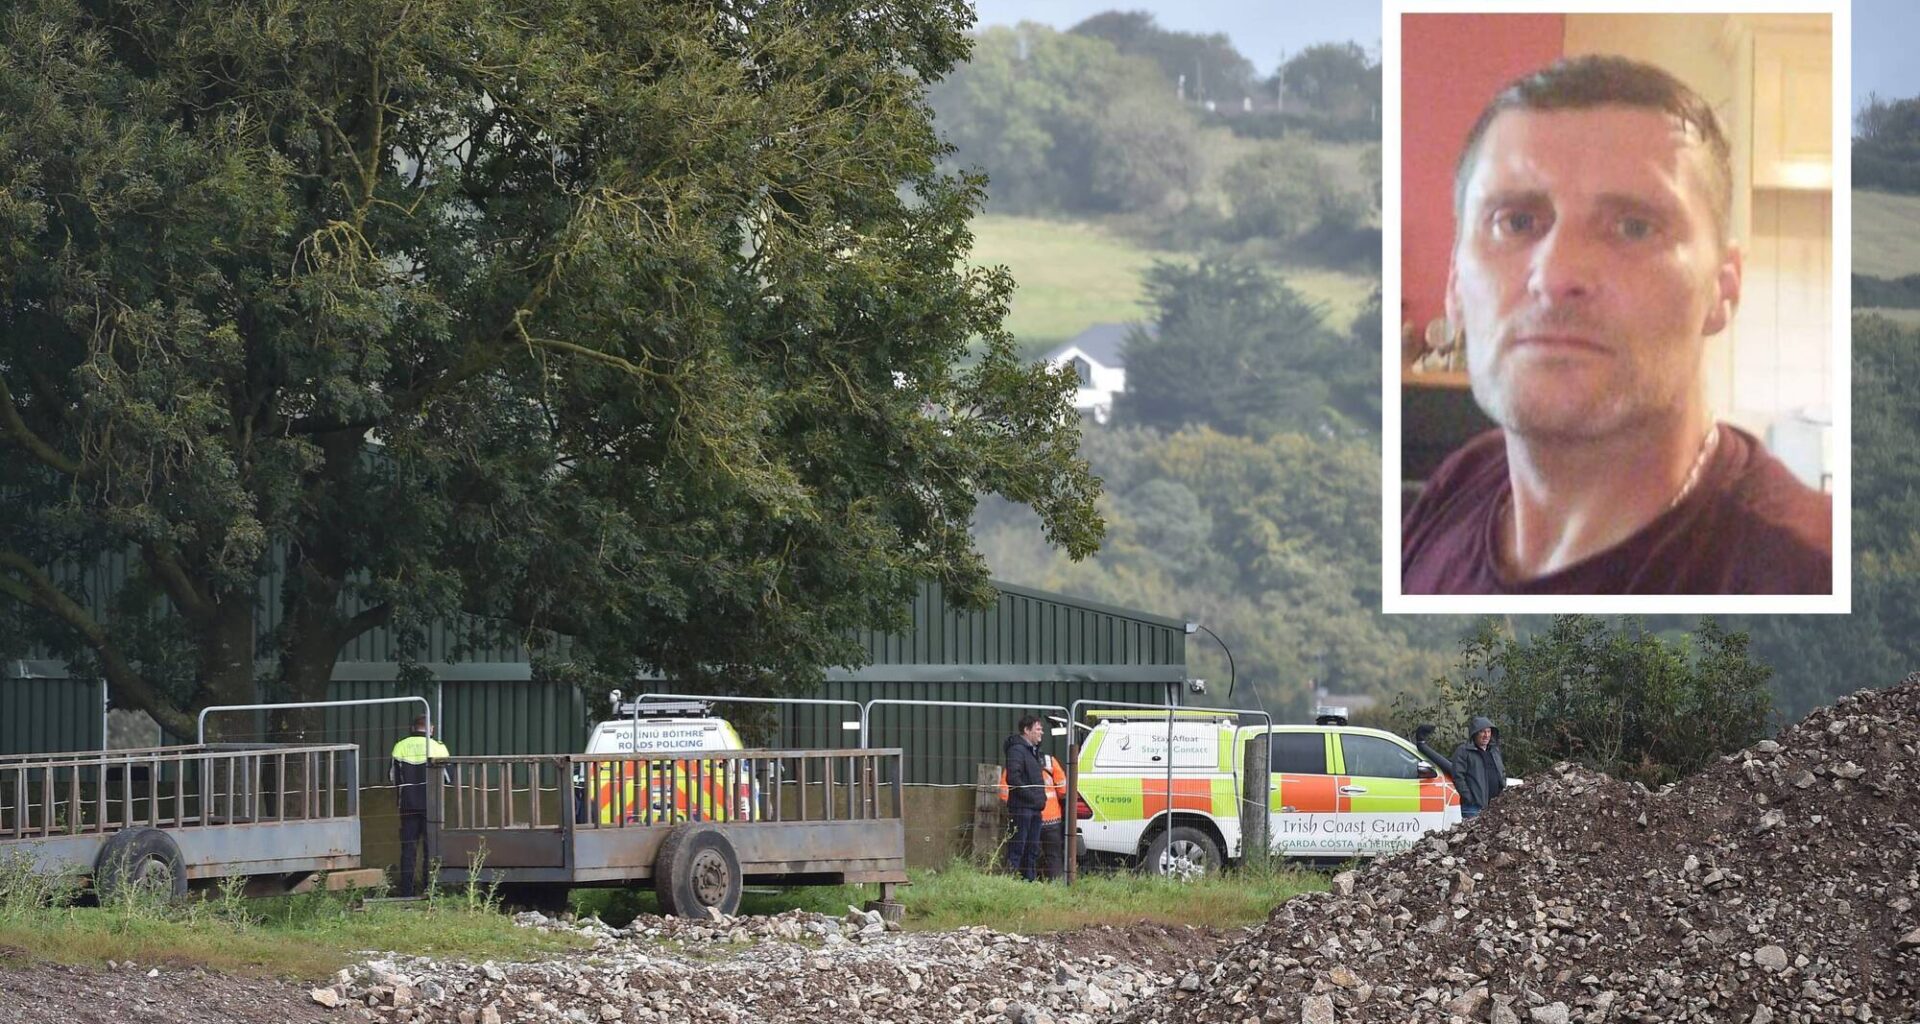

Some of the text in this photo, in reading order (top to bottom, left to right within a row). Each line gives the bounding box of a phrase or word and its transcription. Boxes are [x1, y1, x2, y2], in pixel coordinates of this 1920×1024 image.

[616, 729, 704, 740] PÓIÍNIÚ BÓITHRE
[1151, 734, 1199, 743] Stay Afloat
[656, 740, 703, 748] POLICING
[1141, 745, 1159, 754] Stay
[1173, 745, 1208, 753] Contact
[1283, 814, 1420, 834] Irish Coast Guard
[1281, 839, 1317, 848] GARDA
